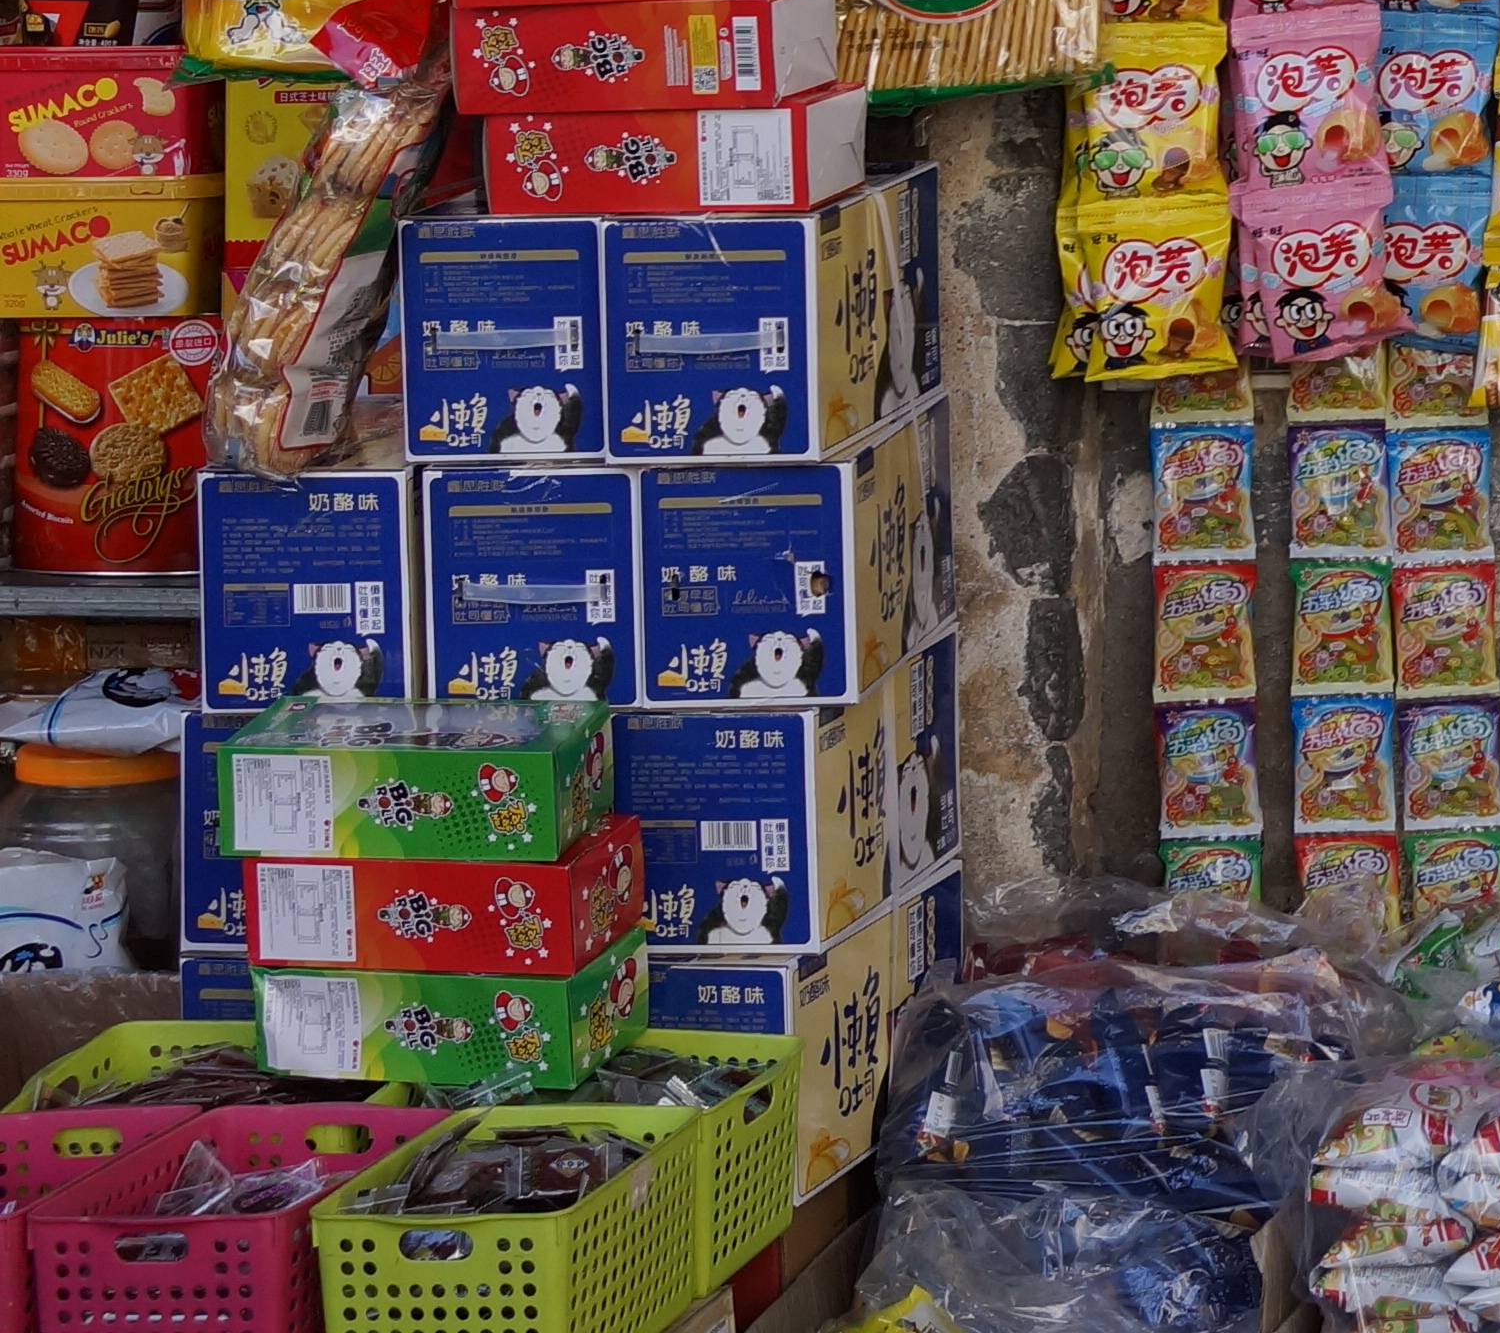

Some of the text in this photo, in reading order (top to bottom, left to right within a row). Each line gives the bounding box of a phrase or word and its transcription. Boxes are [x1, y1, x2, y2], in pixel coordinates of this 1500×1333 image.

[8, 76, 118, 135] SUMACO
[1, 215, 113, 266] SUMACO
[95, 328, 150, 347] Julie's
[307, 489, 381, 514] 奶酪味
